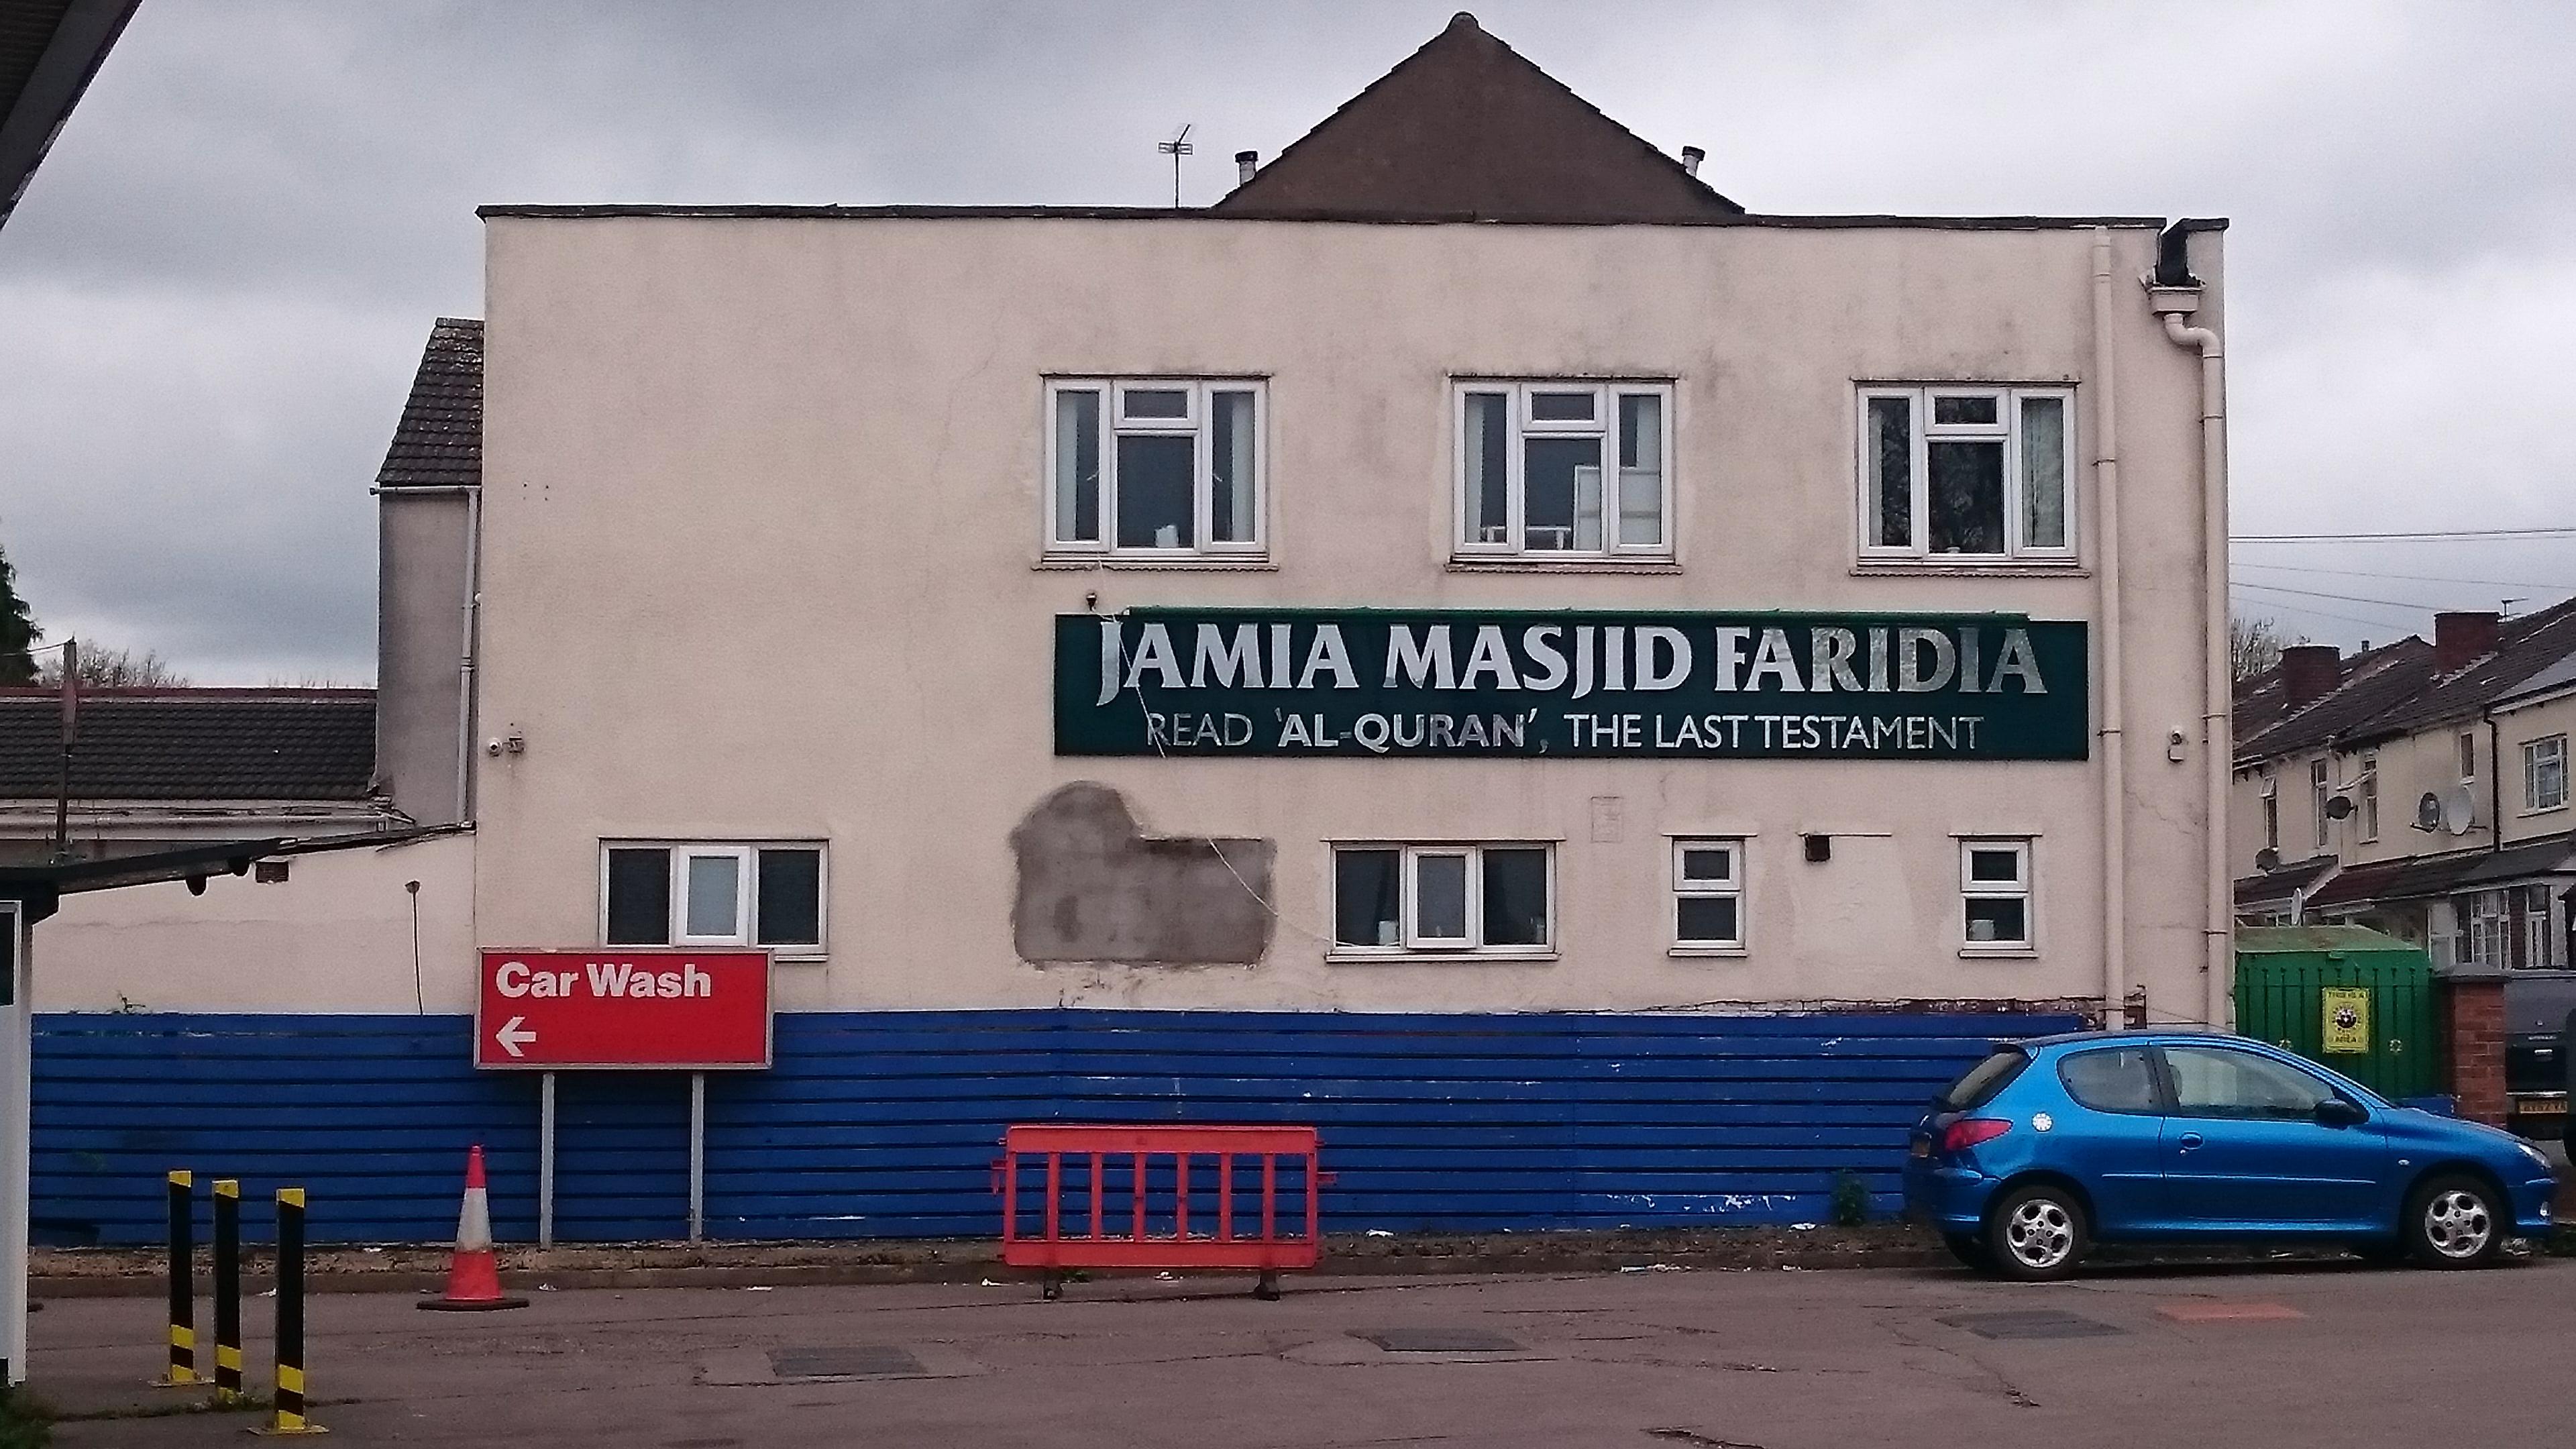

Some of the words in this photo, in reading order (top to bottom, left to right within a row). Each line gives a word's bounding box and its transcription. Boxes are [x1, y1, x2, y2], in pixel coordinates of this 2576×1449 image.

[1097, 621, 1359, 706] JAMIA
[1383, 625, 1692, 699] MASJID
[1715, 625, 2048, 694] FARIDIA
[1146, 713, 1254, 747] READ
[1564, 714, 1642, 748] THE
[1656, 714, 1750, 749] LAST
[1756, 716, 1984, 750] TESTAMENT
[495, 961, 579, 998] Car
[586, 963, 712, 998] Wash
